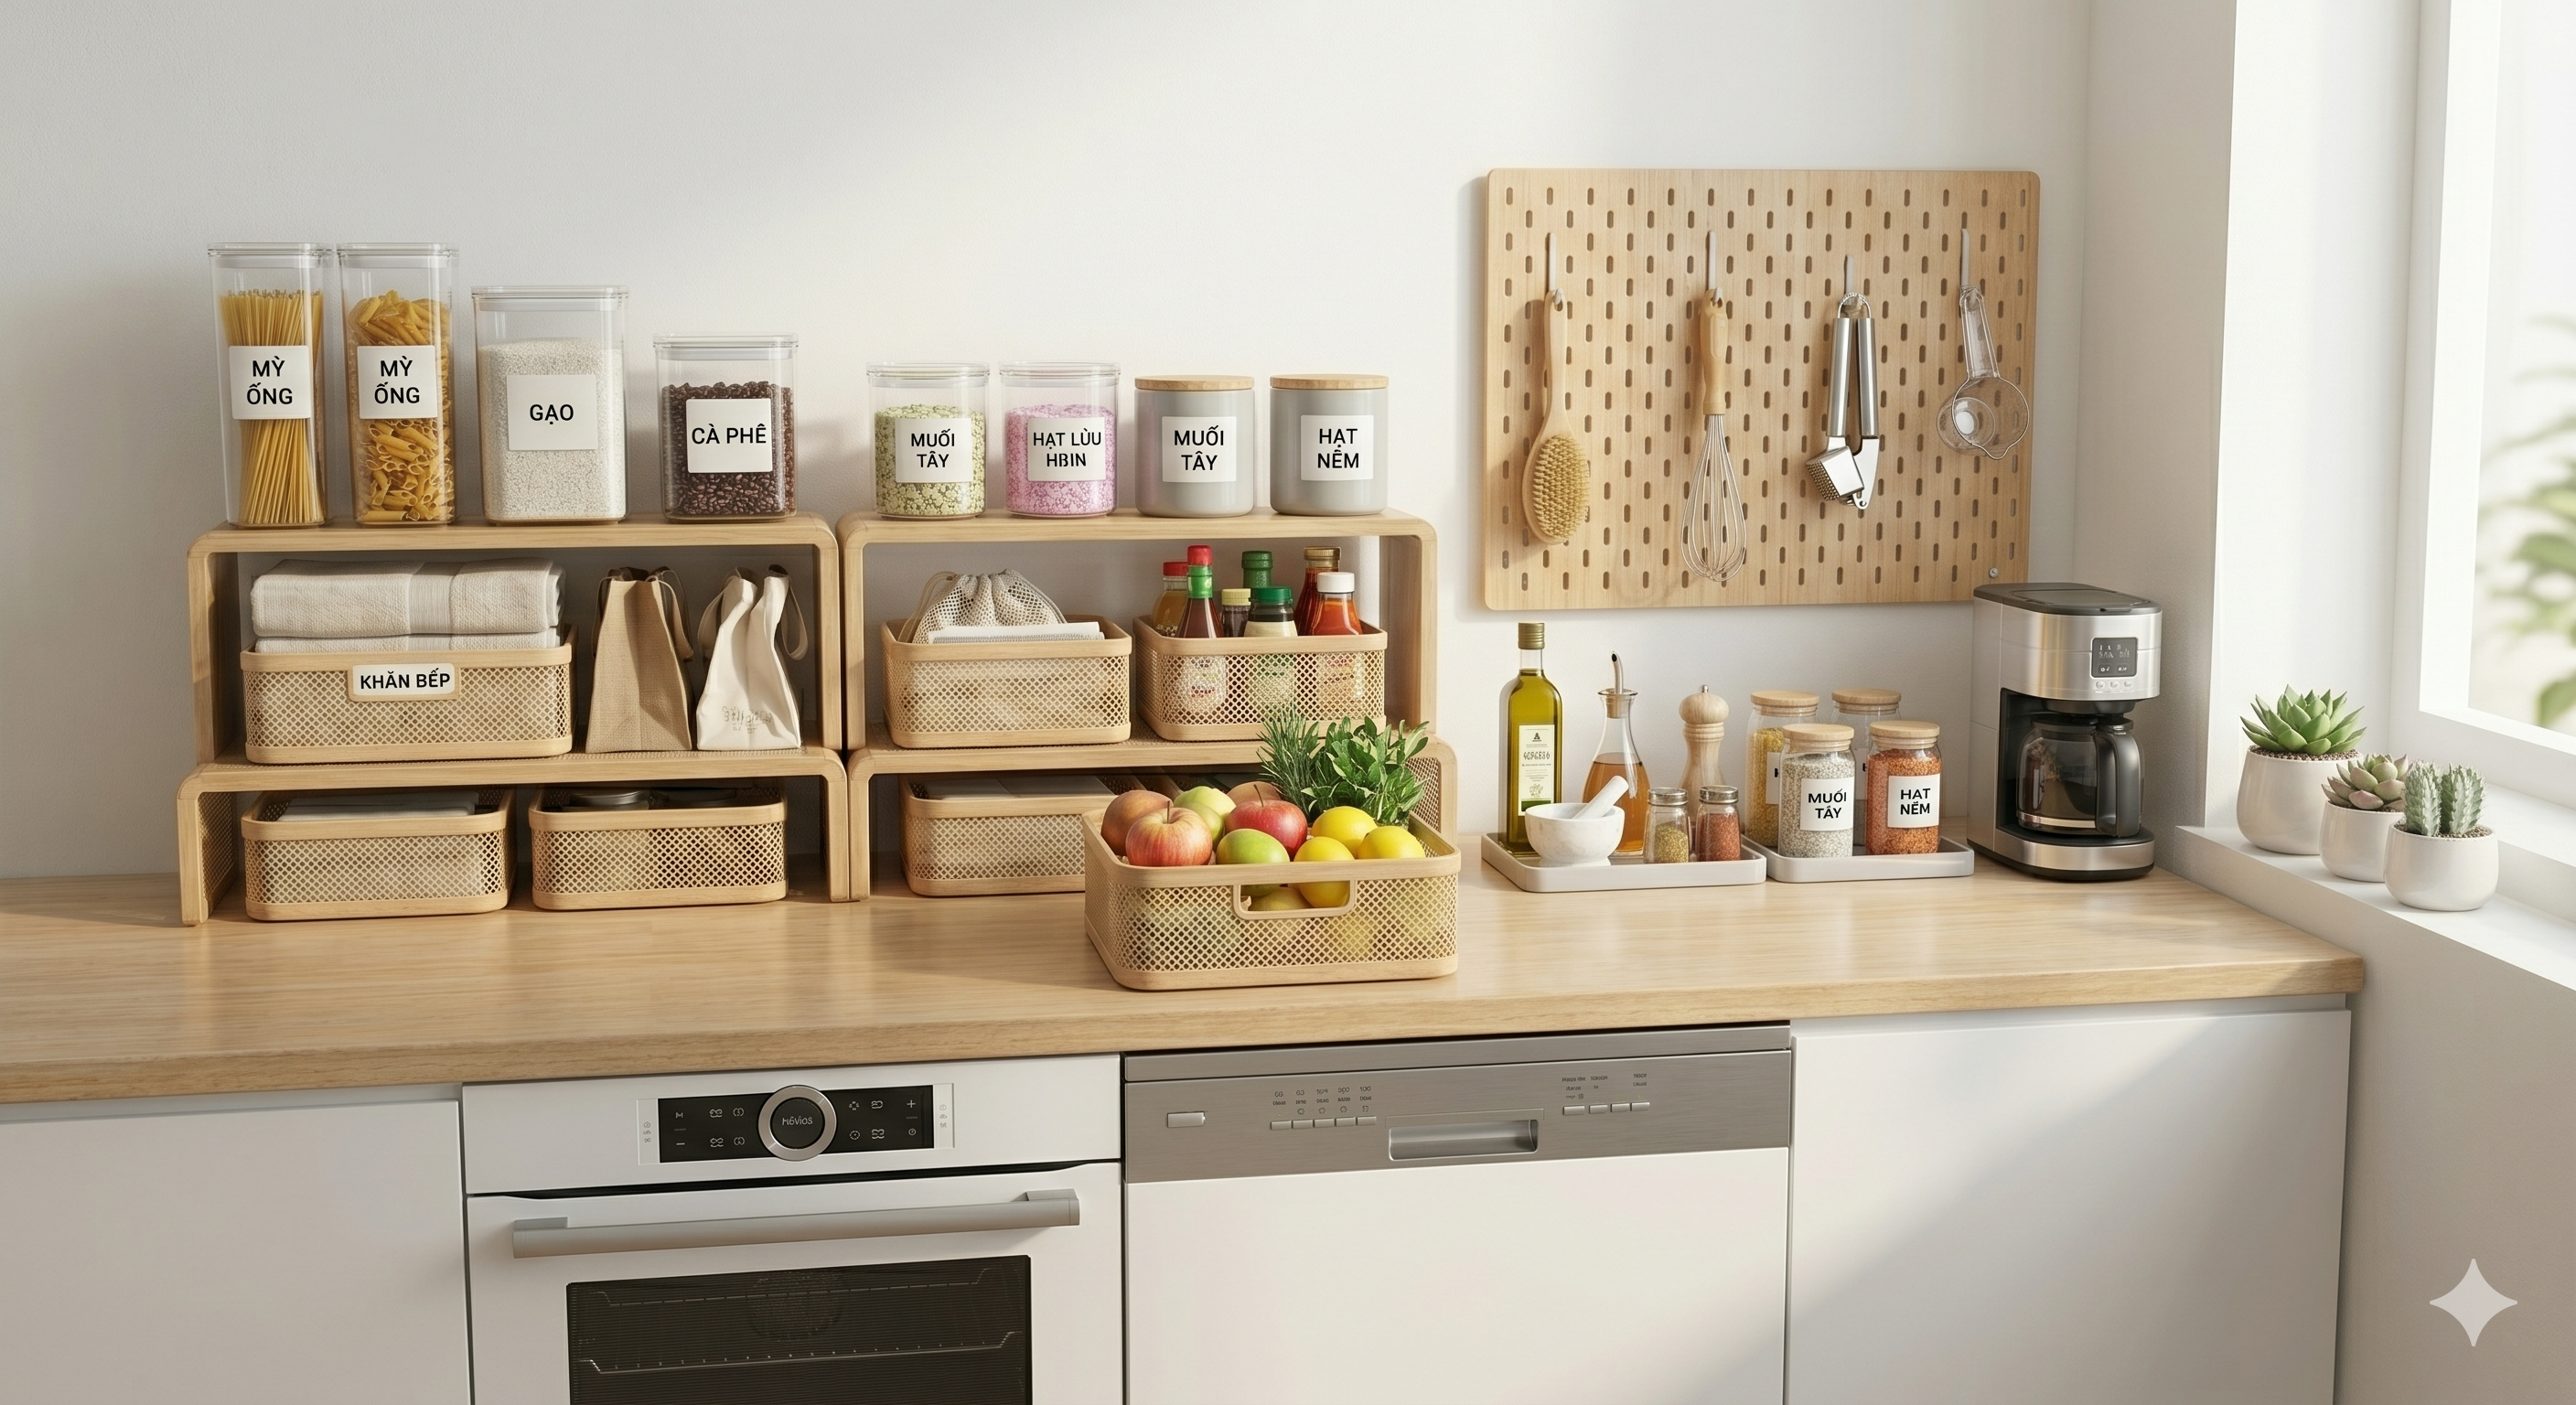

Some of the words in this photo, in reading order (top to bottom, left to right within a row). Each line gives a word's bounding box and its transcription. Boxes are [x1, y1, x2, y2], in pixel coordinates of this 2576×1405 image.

[252, 355, 285, 377] MỲ
[380, 355, 413, 377] MỲ
[246, 381, 293, 405] ỐNG
[374, 381, 420, 404] ỐNG
[529, 403, 574, 425] GẠO
[692, 423, 720, 445] CÀ
[726, 423, 767, 445] PHÊ
[910, 428, 955, 447] MUỐI
[1033, 432, 1066, 450] HẠT
[1071, 427, 1101, 446] LÙU
[1174, 424, 1224, 446] MUỐI
[1319, 428, 1358, 448] HẠT
[916, 450, 950, 468] TÂY
[1046, 453, 1087, 467] HBIN
[1180, 450, 1218, 471] TÂY
[1317, 448, 1359, 469] NÊM
[360, 670, 410, 690] KHĂN
[415, 667, 451, 688] BẾP
[1900, 788, 1931, 800] HAT
